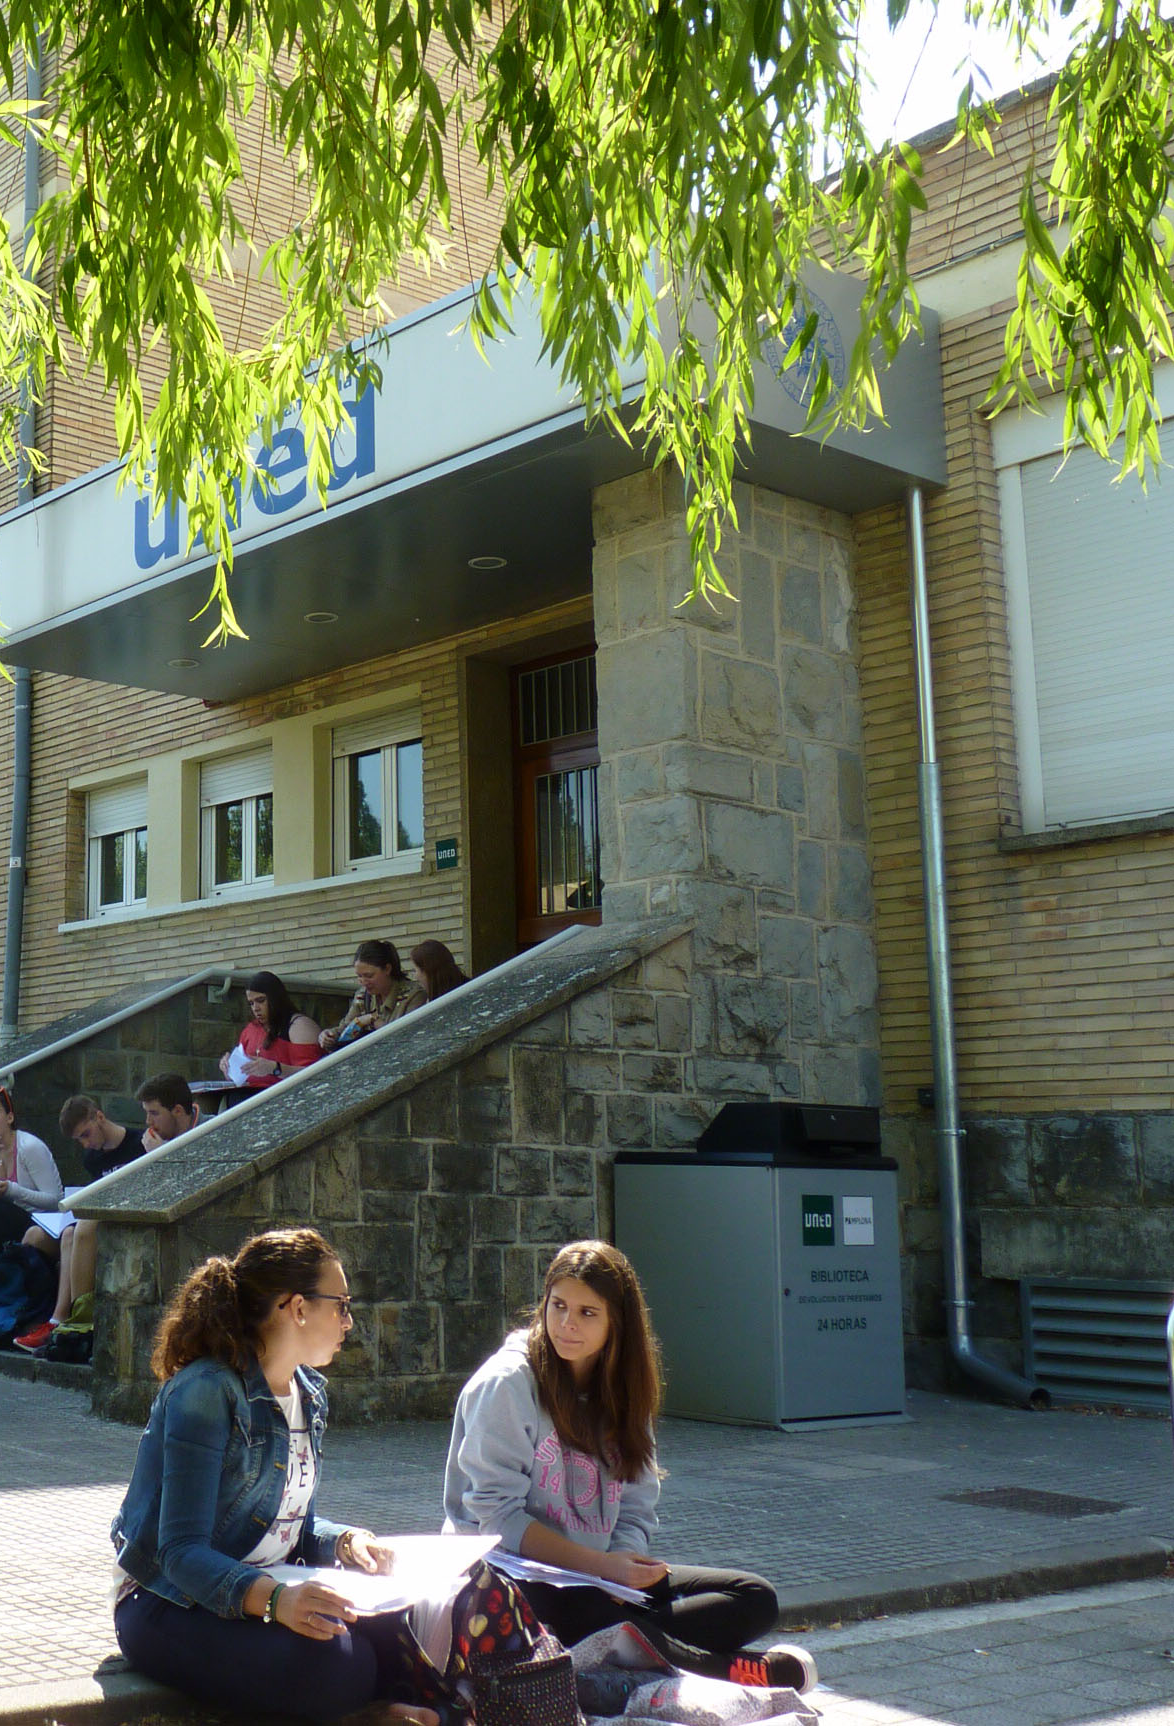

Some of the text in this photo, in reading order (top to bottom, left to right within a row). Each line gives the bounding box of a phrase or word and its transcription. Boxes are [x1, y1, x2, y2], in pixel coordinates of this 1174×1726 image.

[804, 1213, 832, 1228] UNED
[810, 1270, 870, 1283] BIBLIOTECA
[817, 1317, 867, 1331] 24 HORAS
